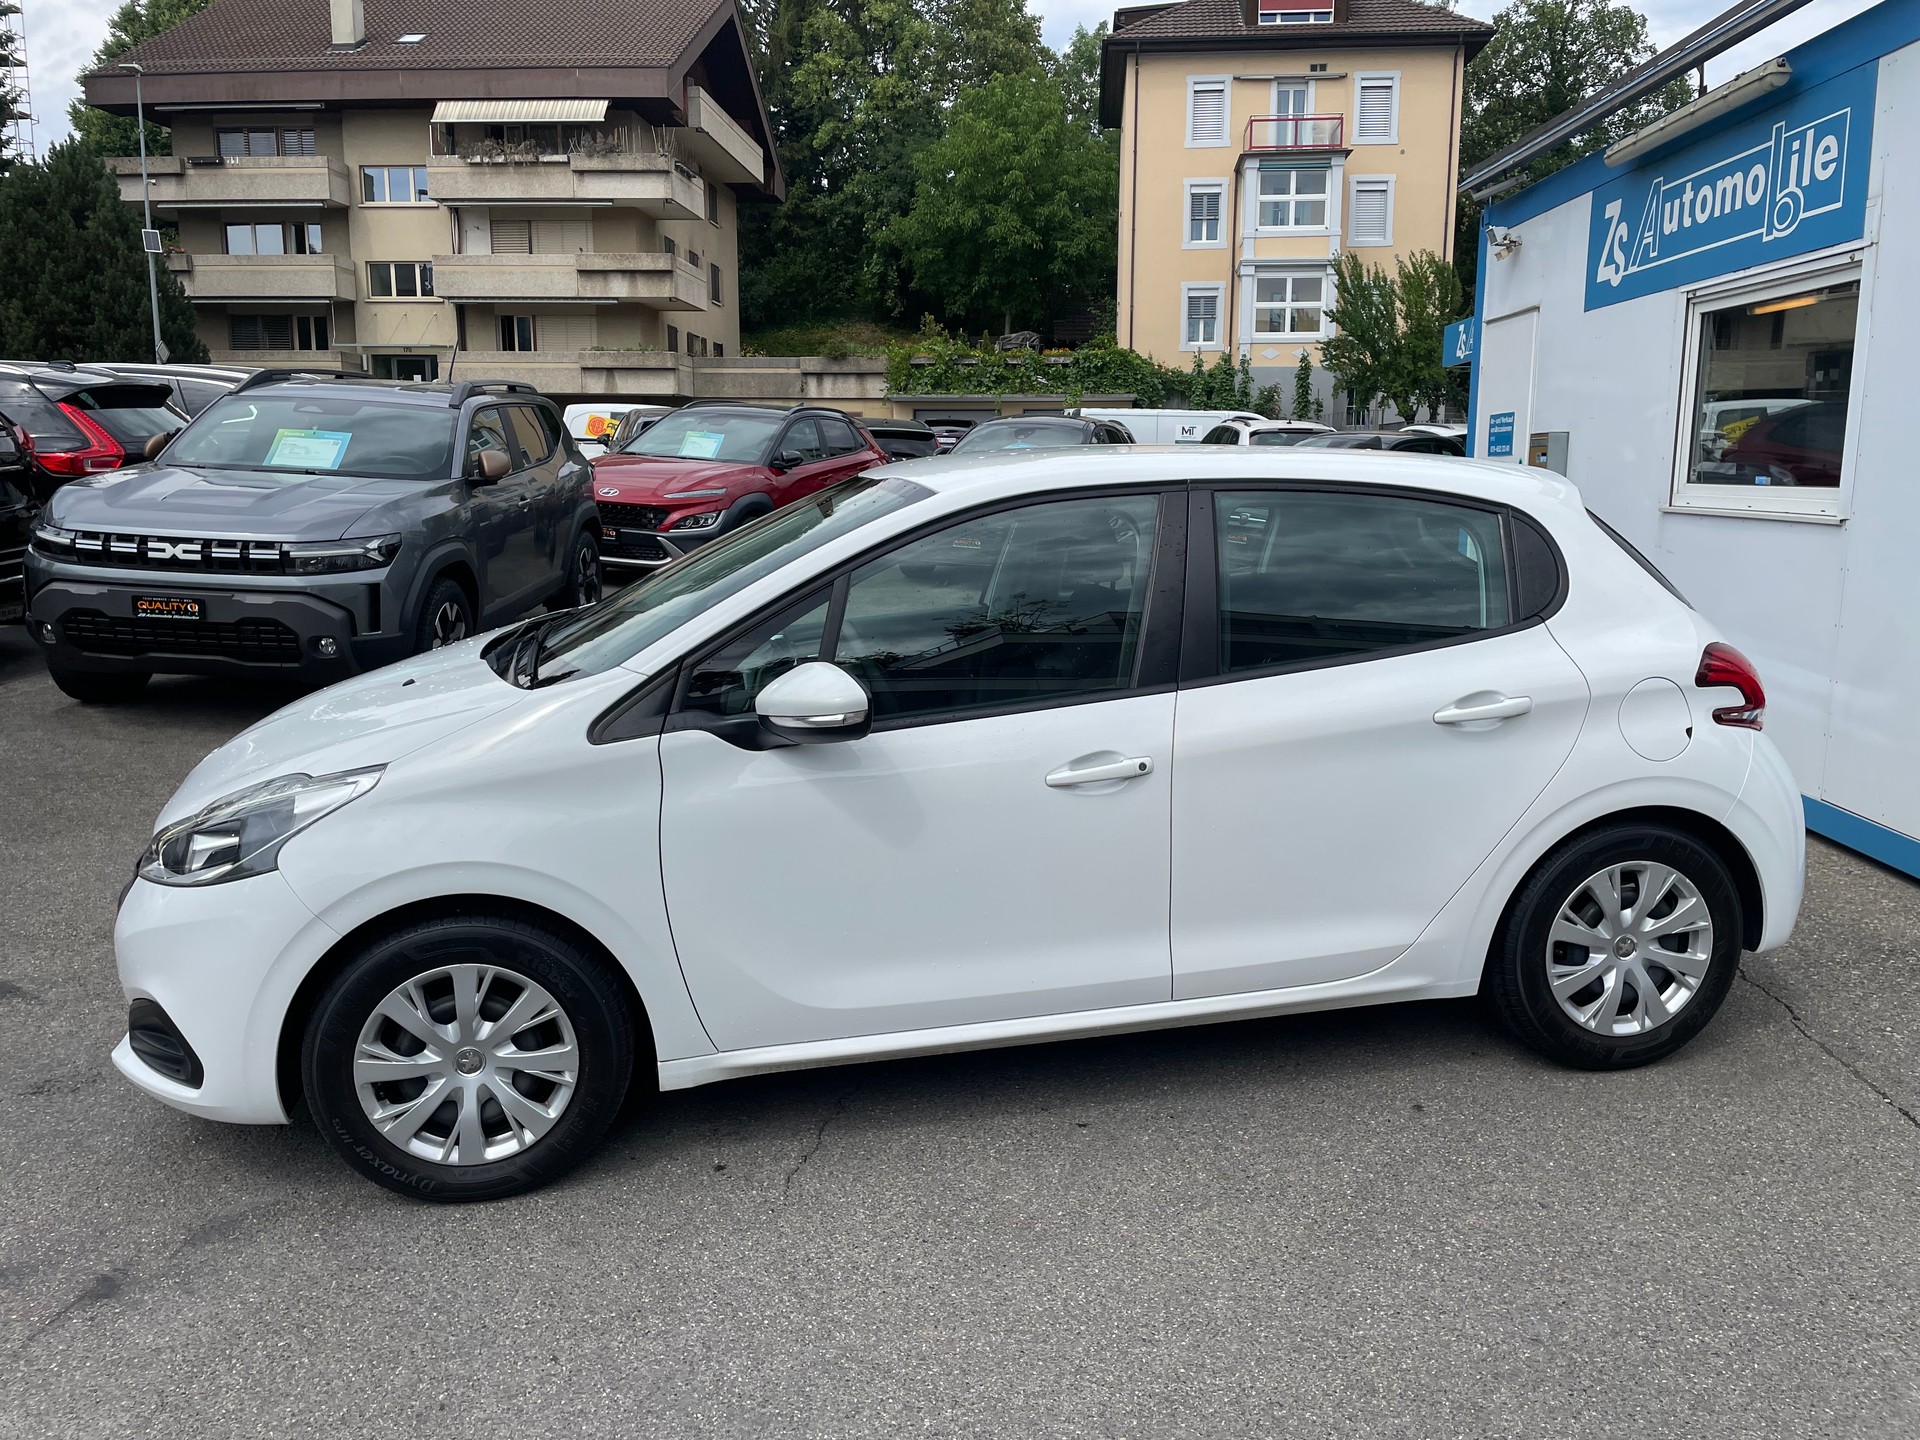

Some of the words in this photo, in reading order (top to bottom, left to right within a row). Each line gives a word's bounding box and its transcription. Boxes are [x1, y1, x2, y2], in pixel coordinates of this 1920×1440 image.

[1628, 120, 1839, 269] Automobile
[1181, 426, 1196, 435] MT
[137, 601, 187, 610] QUALITY
[353, 1143, 438, 1193] Dynaxer
